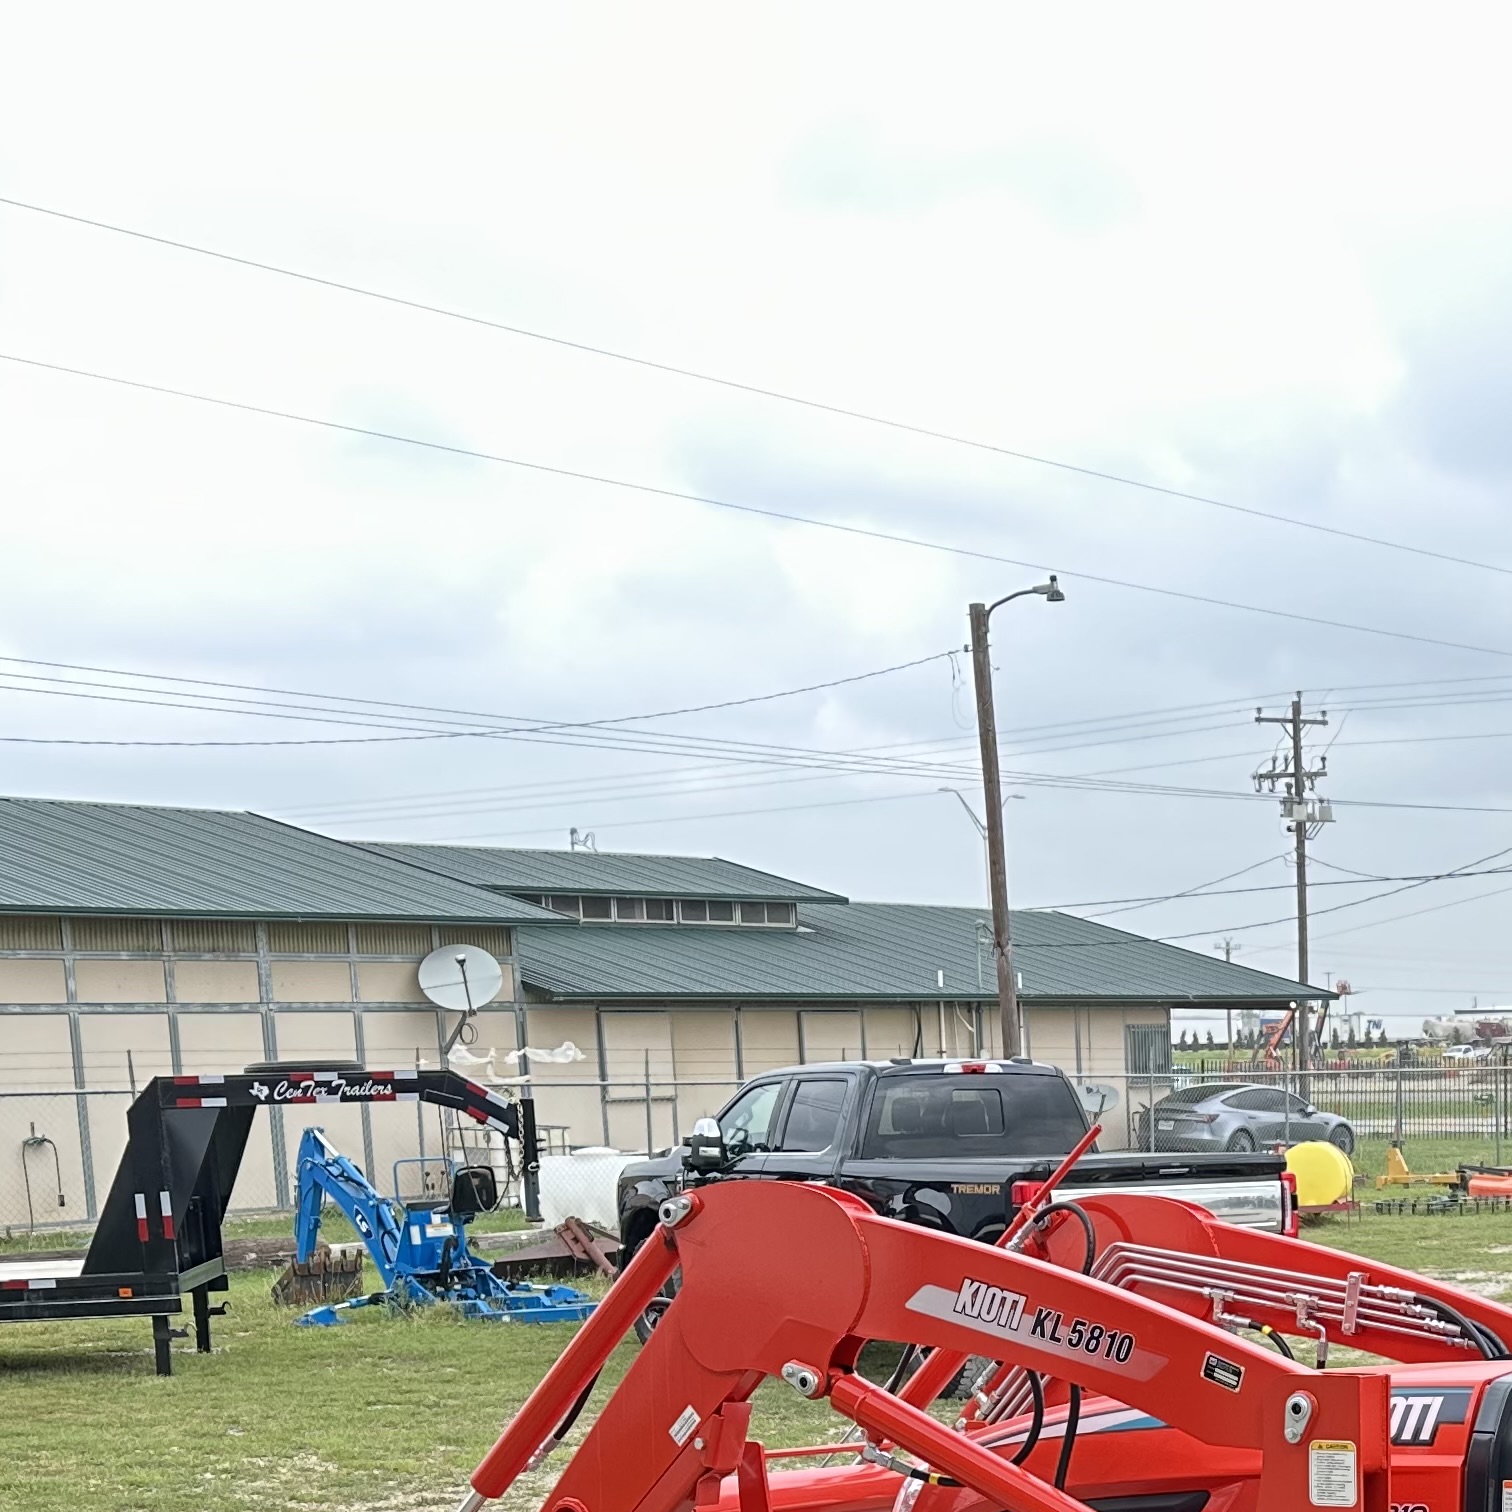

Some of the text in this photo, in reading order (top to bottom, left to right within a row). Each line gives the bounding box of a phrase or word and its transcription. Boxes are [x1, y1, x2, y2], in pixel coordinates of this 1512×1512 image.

[273, 1080, 328, 1100] CenTex
[331, 1079, 393, 1098] Trailers
[950, 1184, 1000, 1195] TREMOR
[355, 1213, 369, 1233] LS
[954, 1277, 1027, 1331] KIOTI
